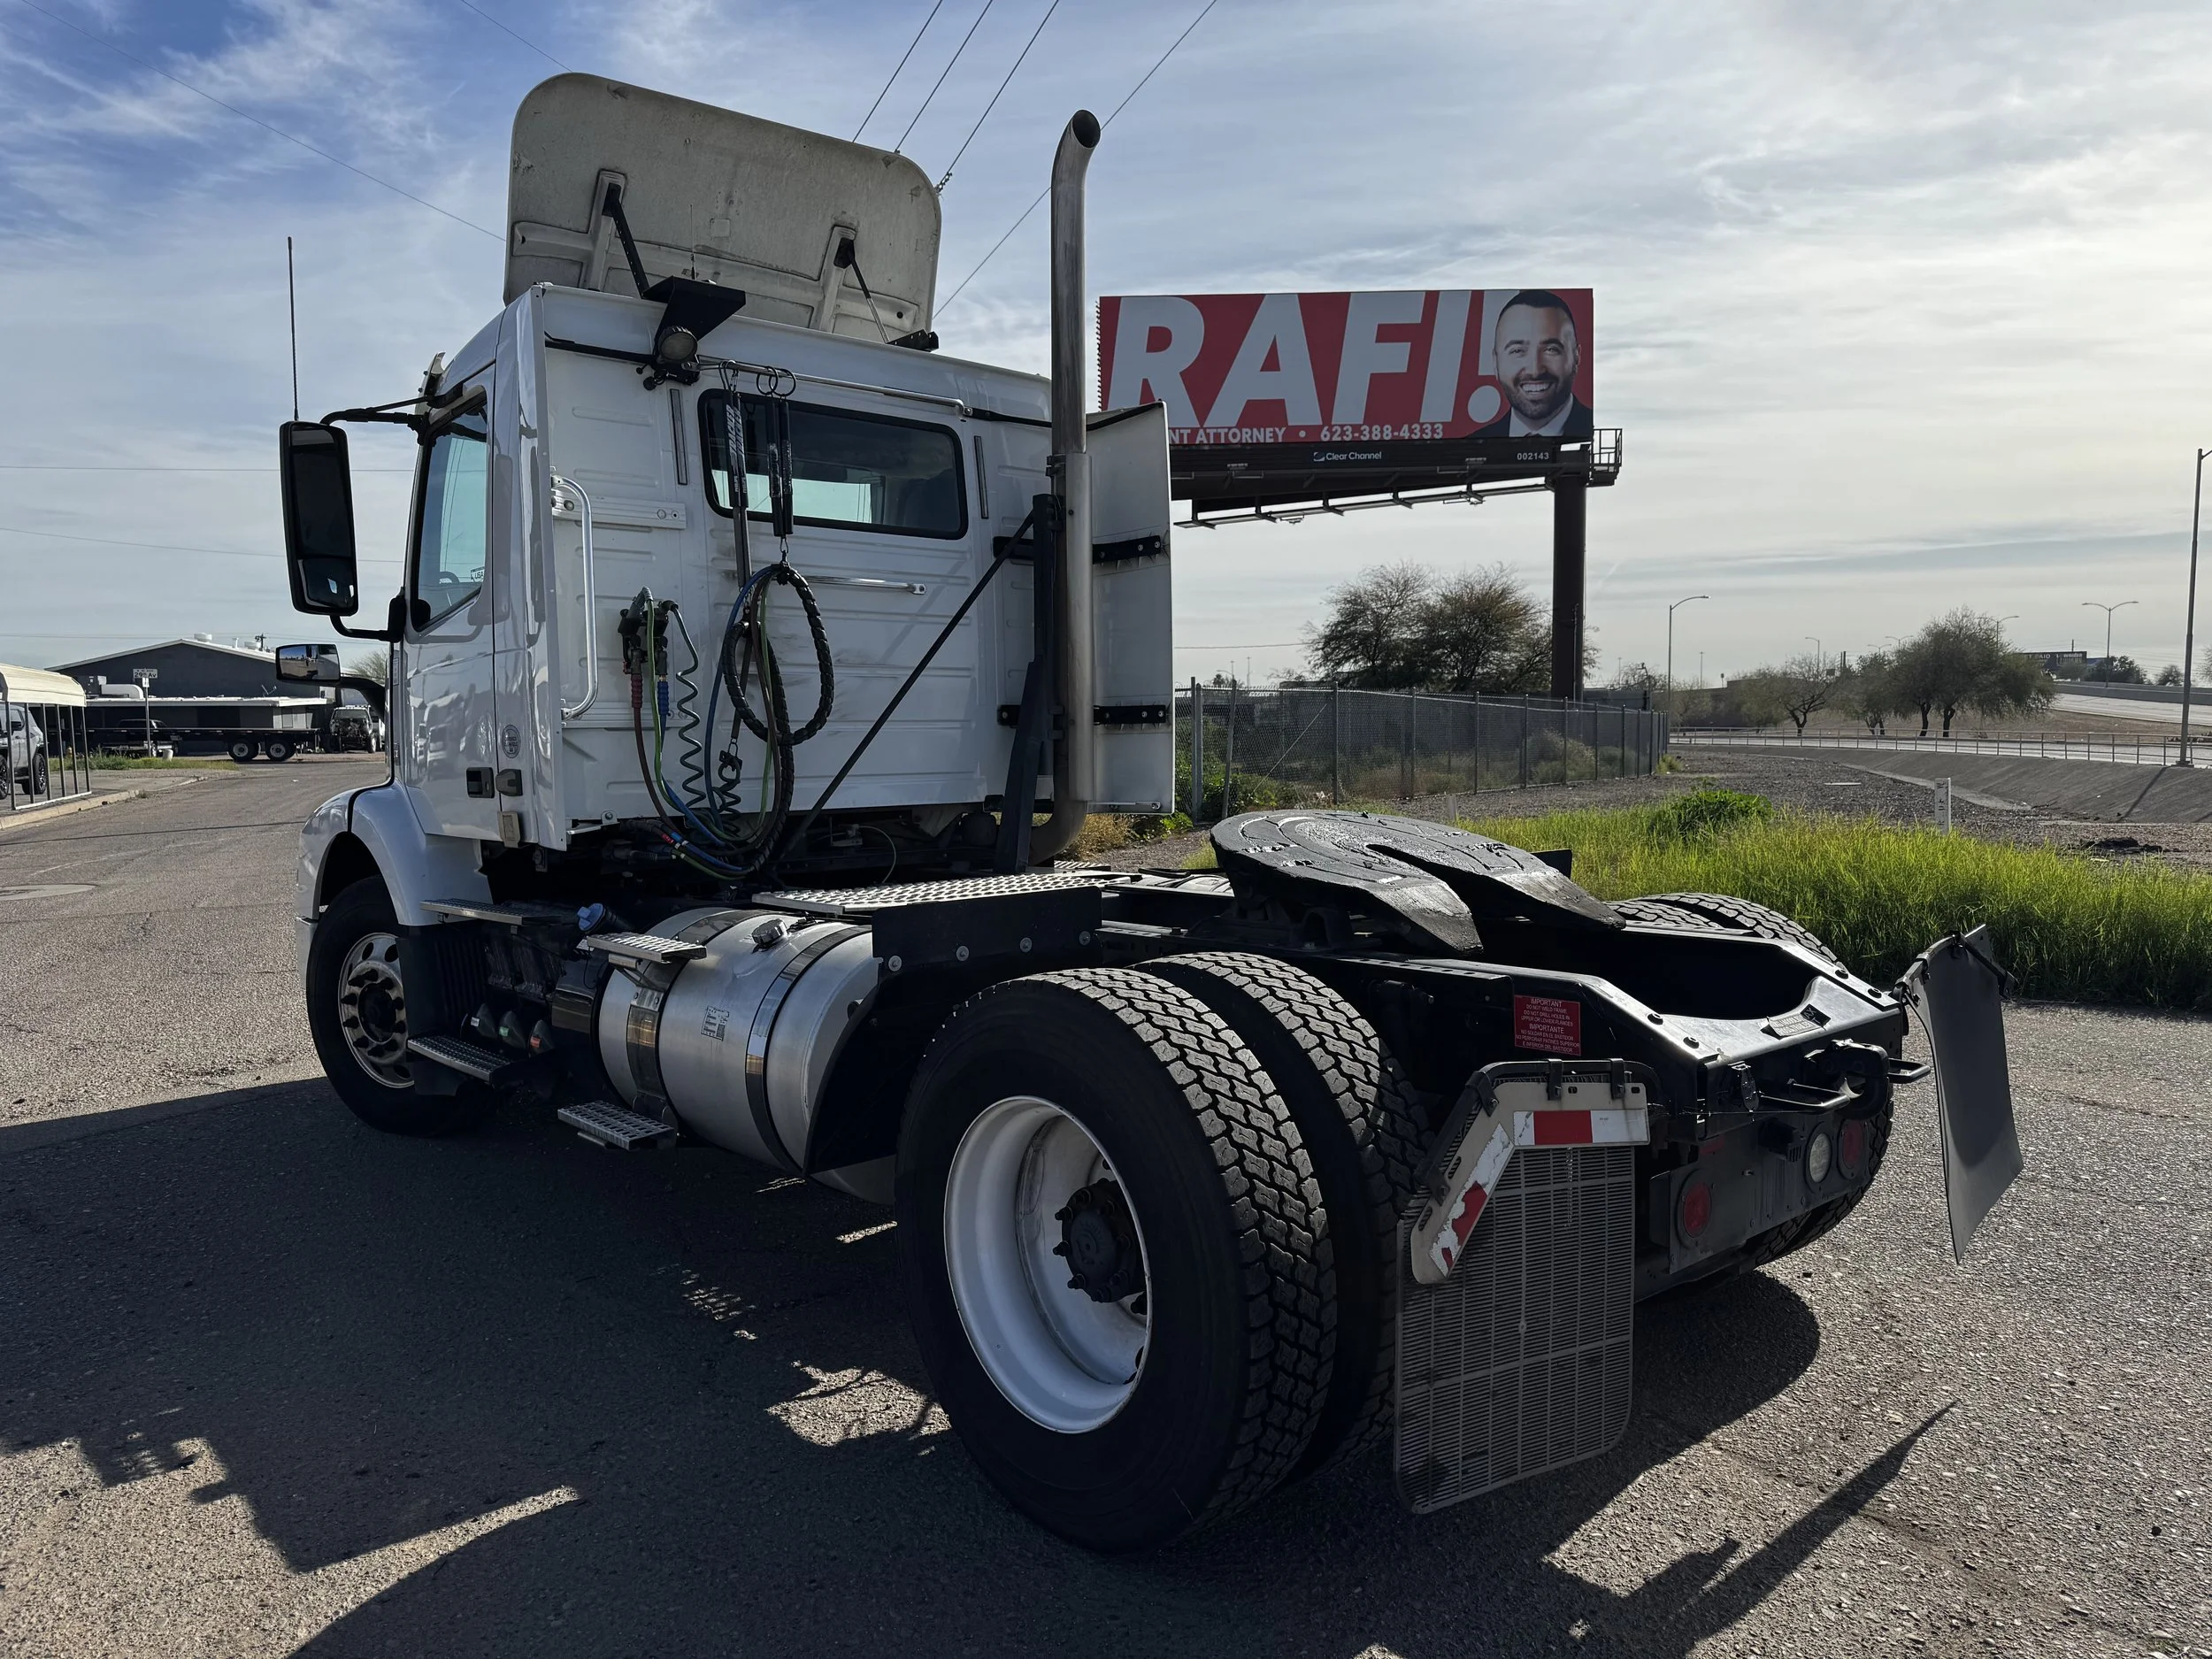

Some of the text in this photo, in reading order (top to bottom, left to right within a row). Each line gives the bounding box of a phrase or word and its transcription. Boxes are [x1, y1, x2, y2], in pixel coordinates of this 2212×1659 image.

[1106, 290, 1520, 427] RAFI!
[1195, 427, 1286, 444] ATTORNEY
[1320, 423, 1443, 442] 623-388-4333
[1325, 451, 1382, 461] Clear Channel
[1531, 998, 1563, 1007] IMPORTANT
[1529, 1023, 1564, 1033] IMPORTANTE
